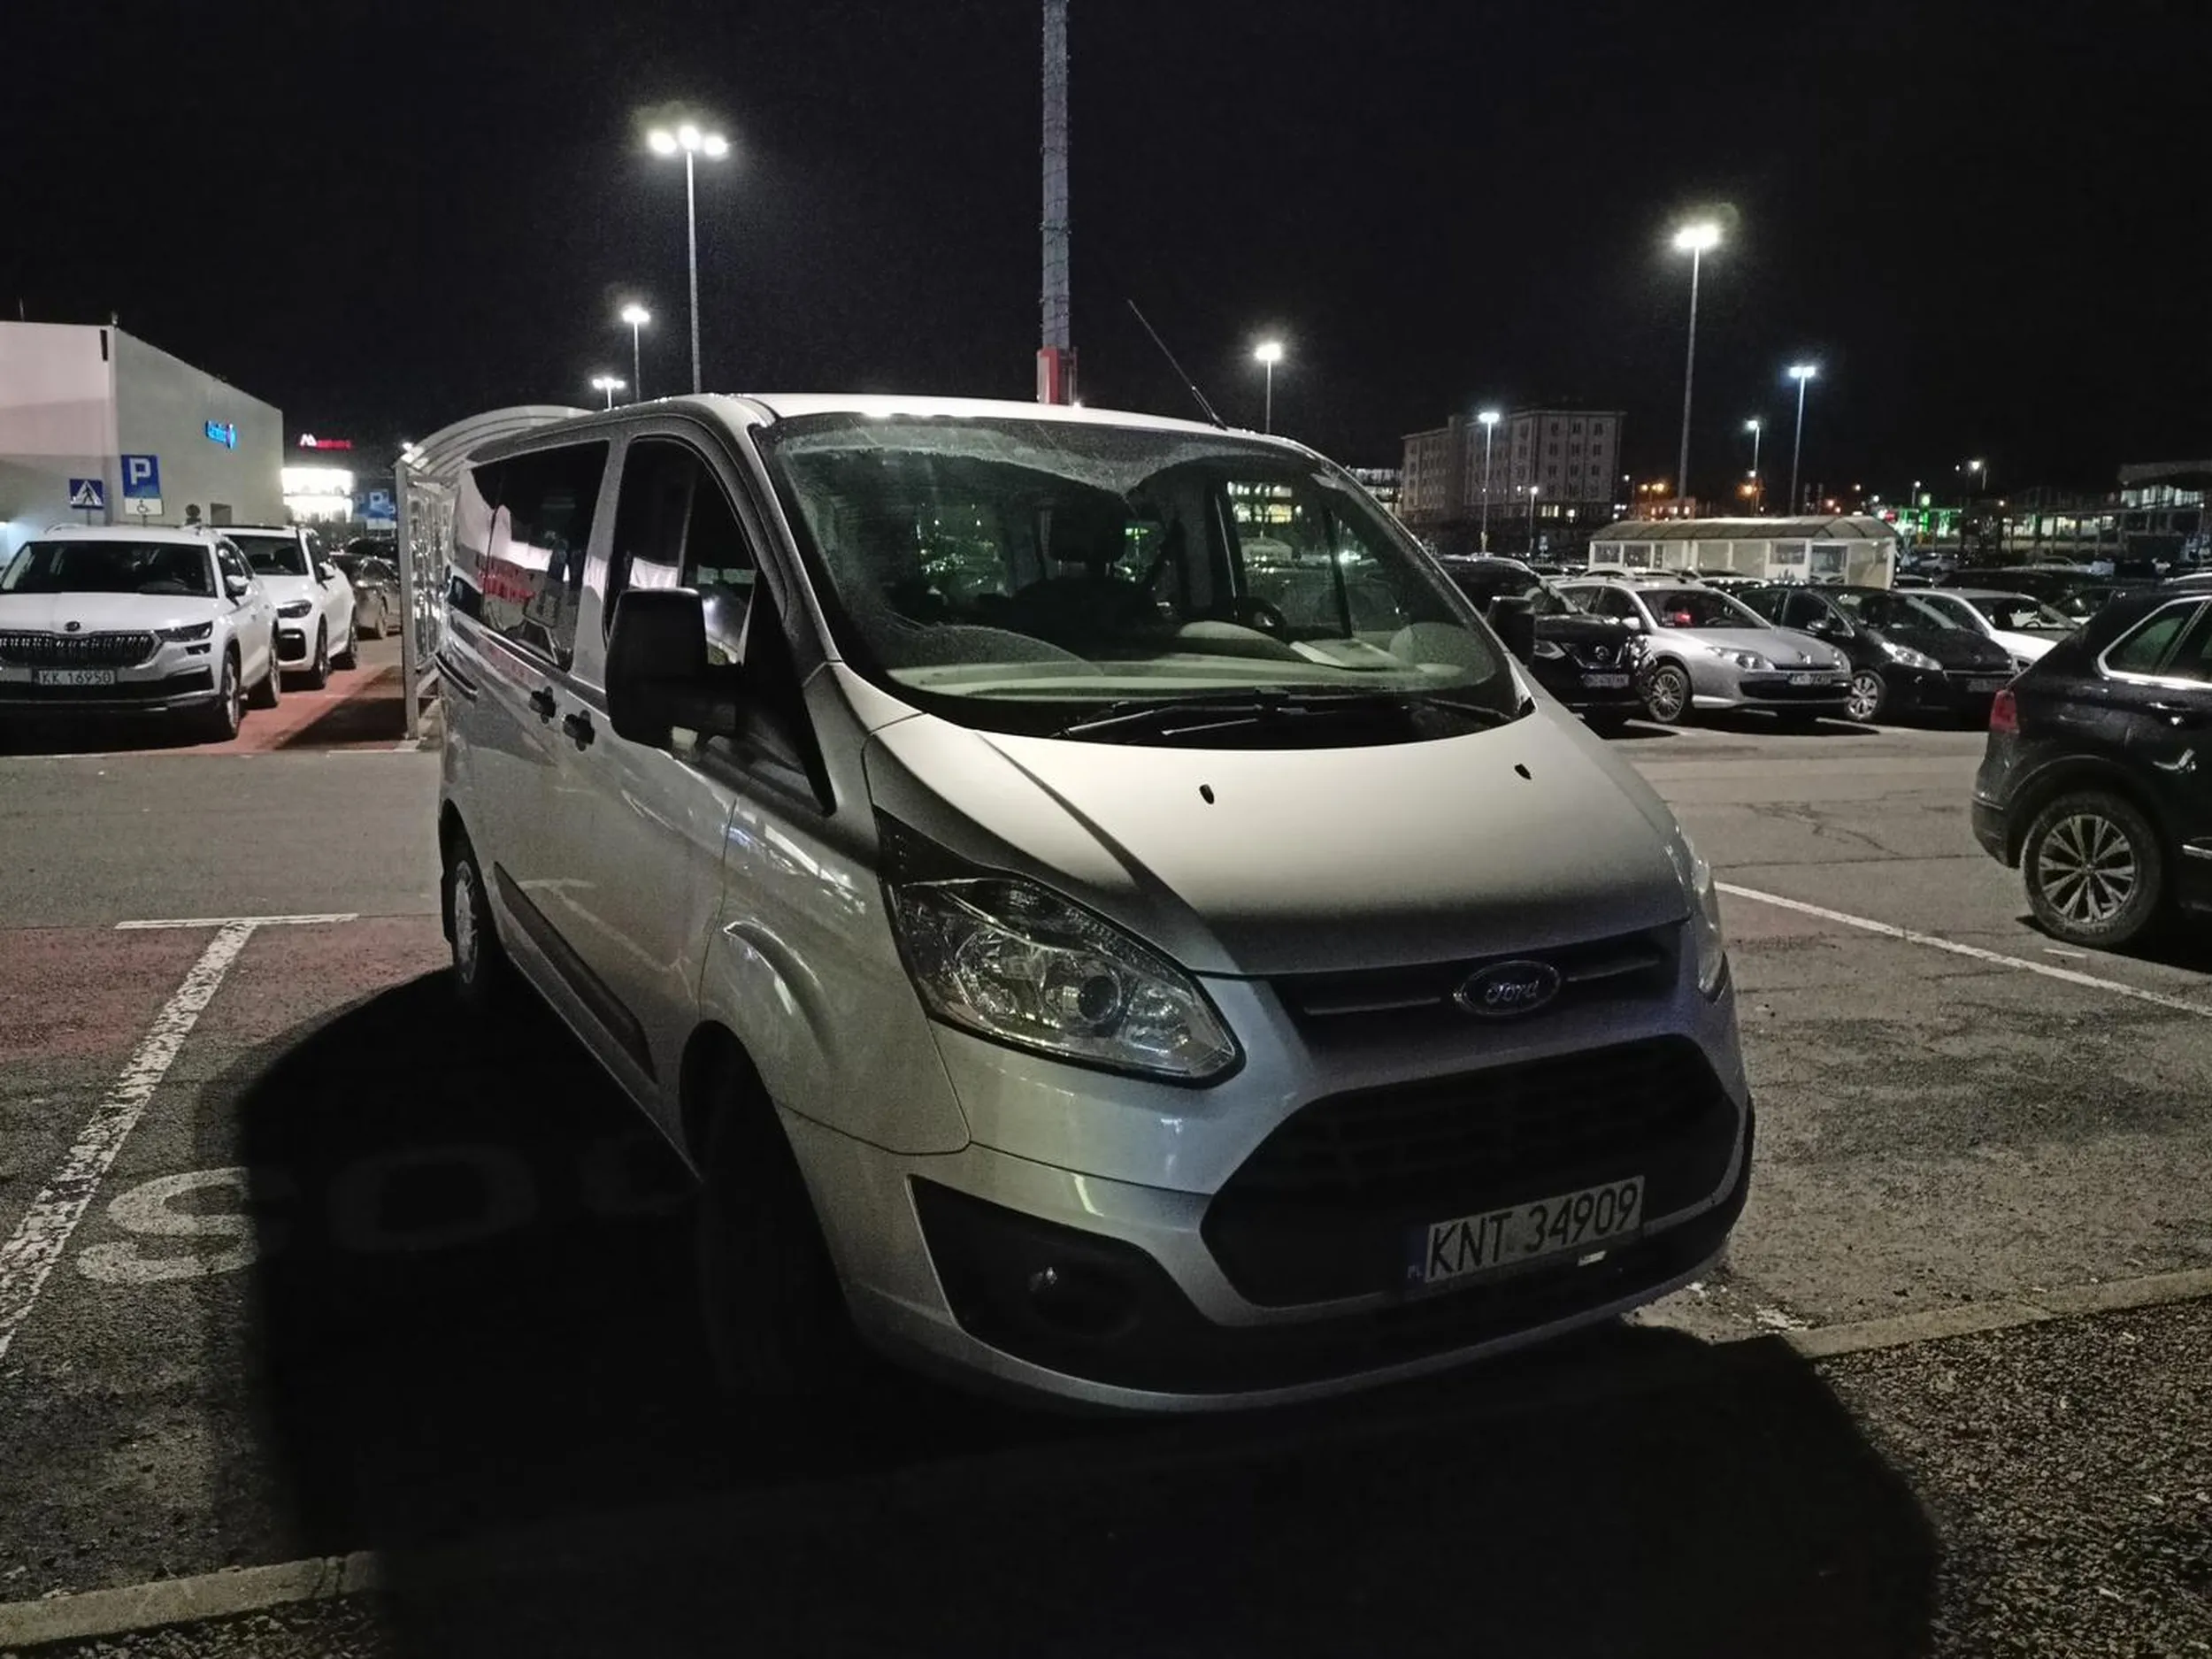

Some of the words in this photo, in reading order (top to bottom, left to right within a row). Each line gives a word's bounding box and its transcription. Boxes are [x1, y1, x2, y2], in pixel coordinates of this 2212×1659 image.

[129, 458, 150, 485] P
[42, 671, 61, 685] KK
[66, 671, 111, 685] 16950
[1485, 979, 1540, 1003] Ford
[1430, 1211, 1512, 1278] KNT
[1525, 1183, 1638, 1252] 34909
